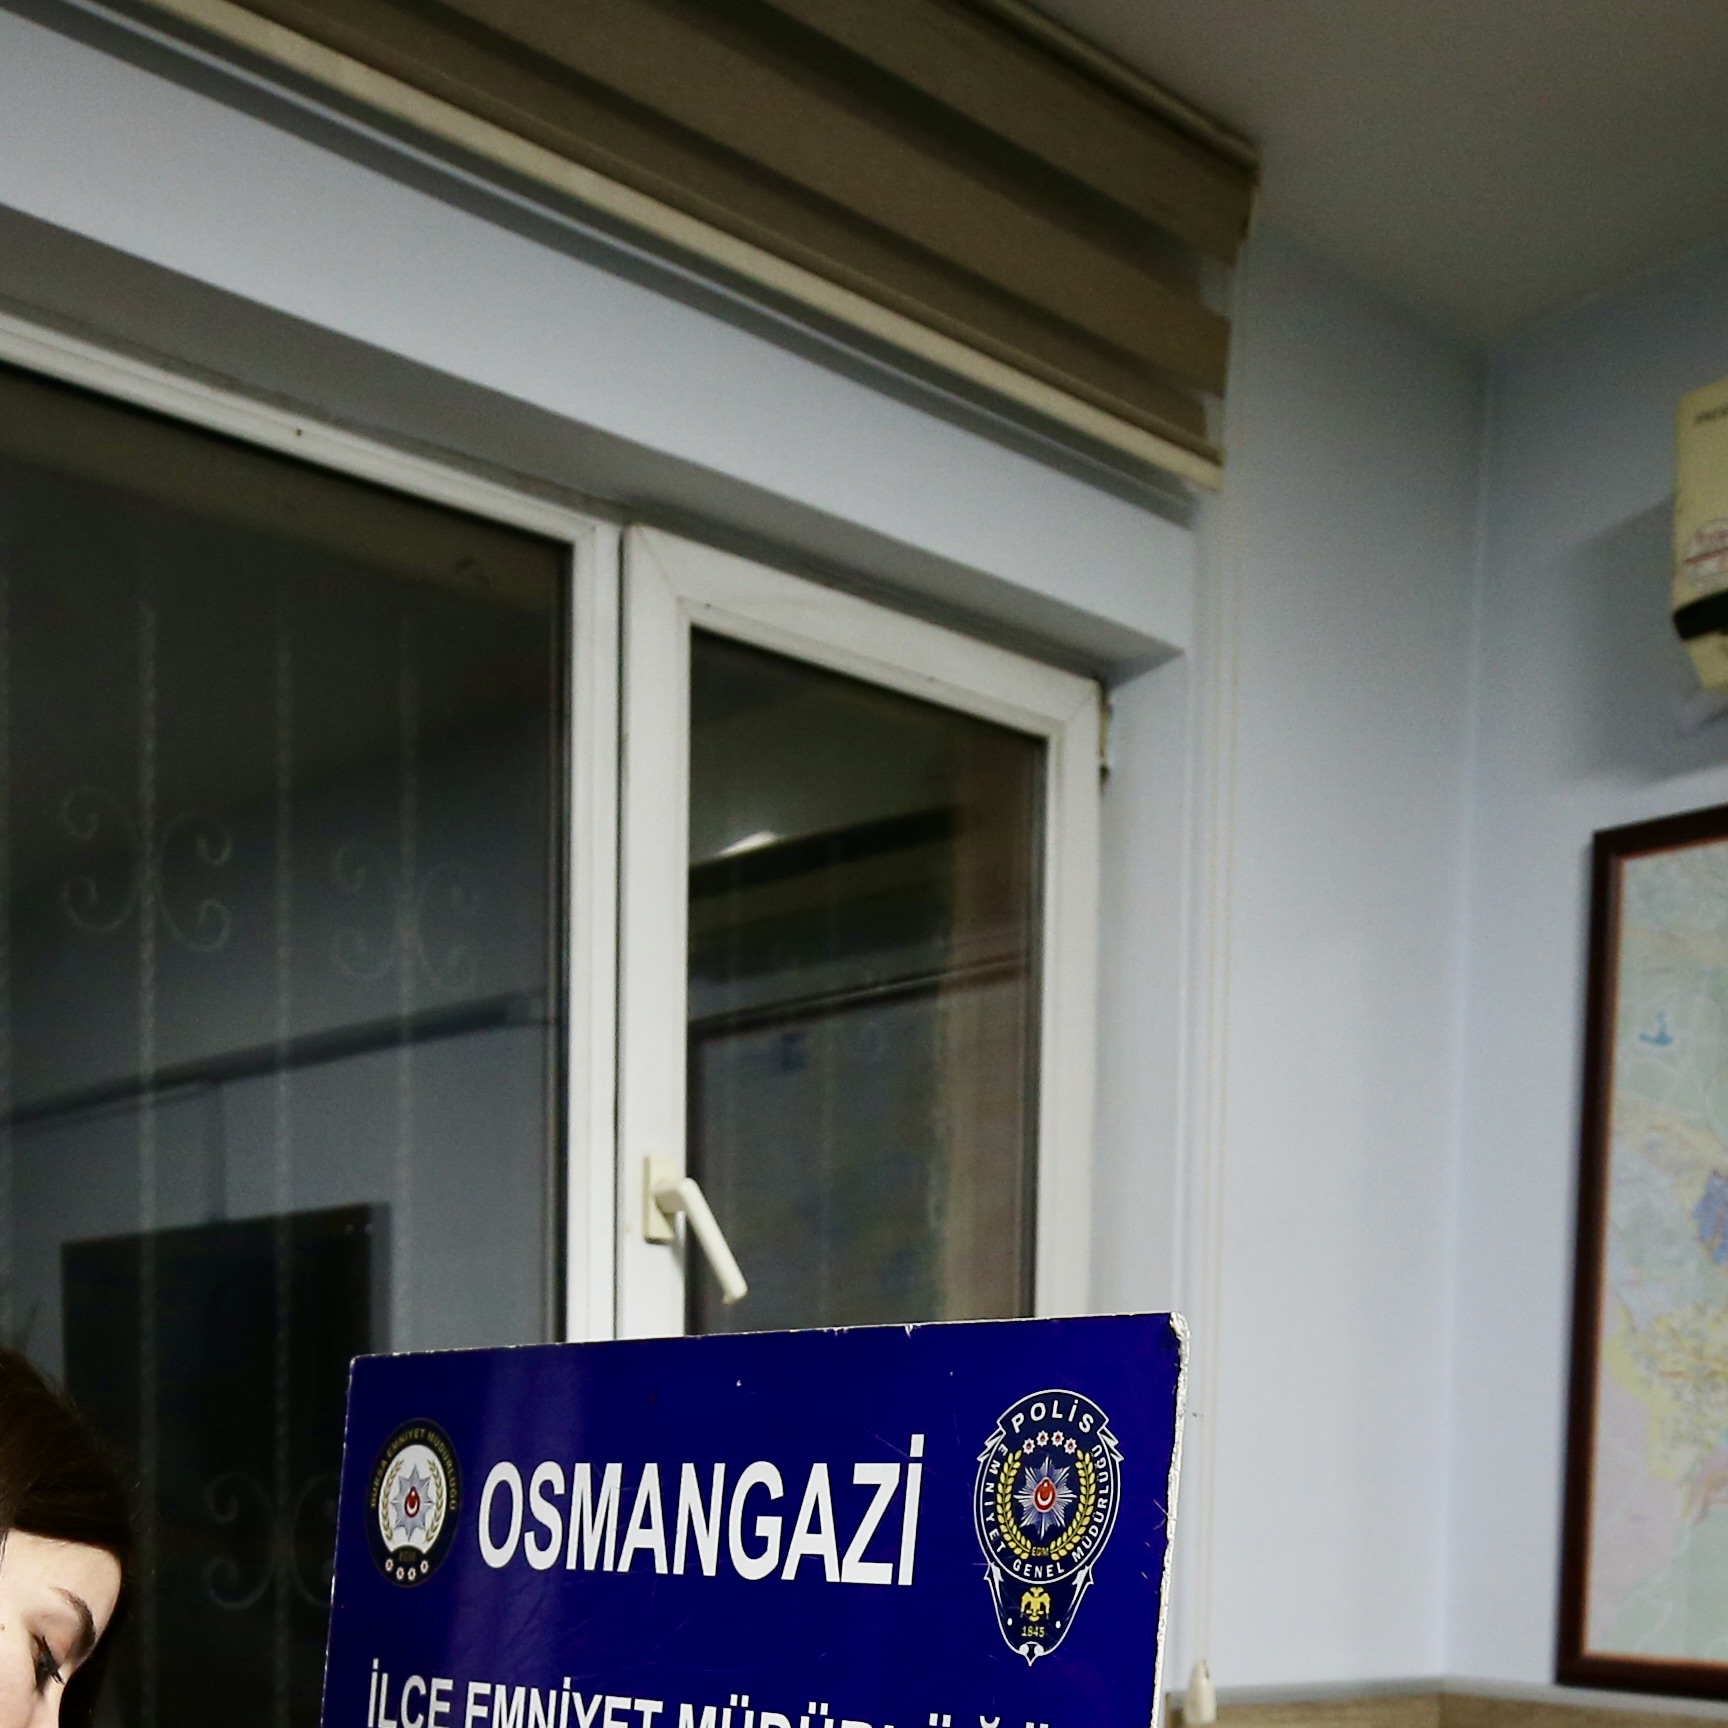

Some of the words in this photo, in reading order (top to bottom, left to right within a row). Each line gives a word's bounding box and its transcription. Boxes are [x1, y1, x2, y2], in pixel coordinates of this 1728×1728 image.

[1011, 1399, 1094, 1434] POLİS
[478, 1434, 924, 1586] OSMANGAZİ
[1012, 1559, 1065, 1579] GENEL
[1020, 1625, 1046, 1638] 1845
